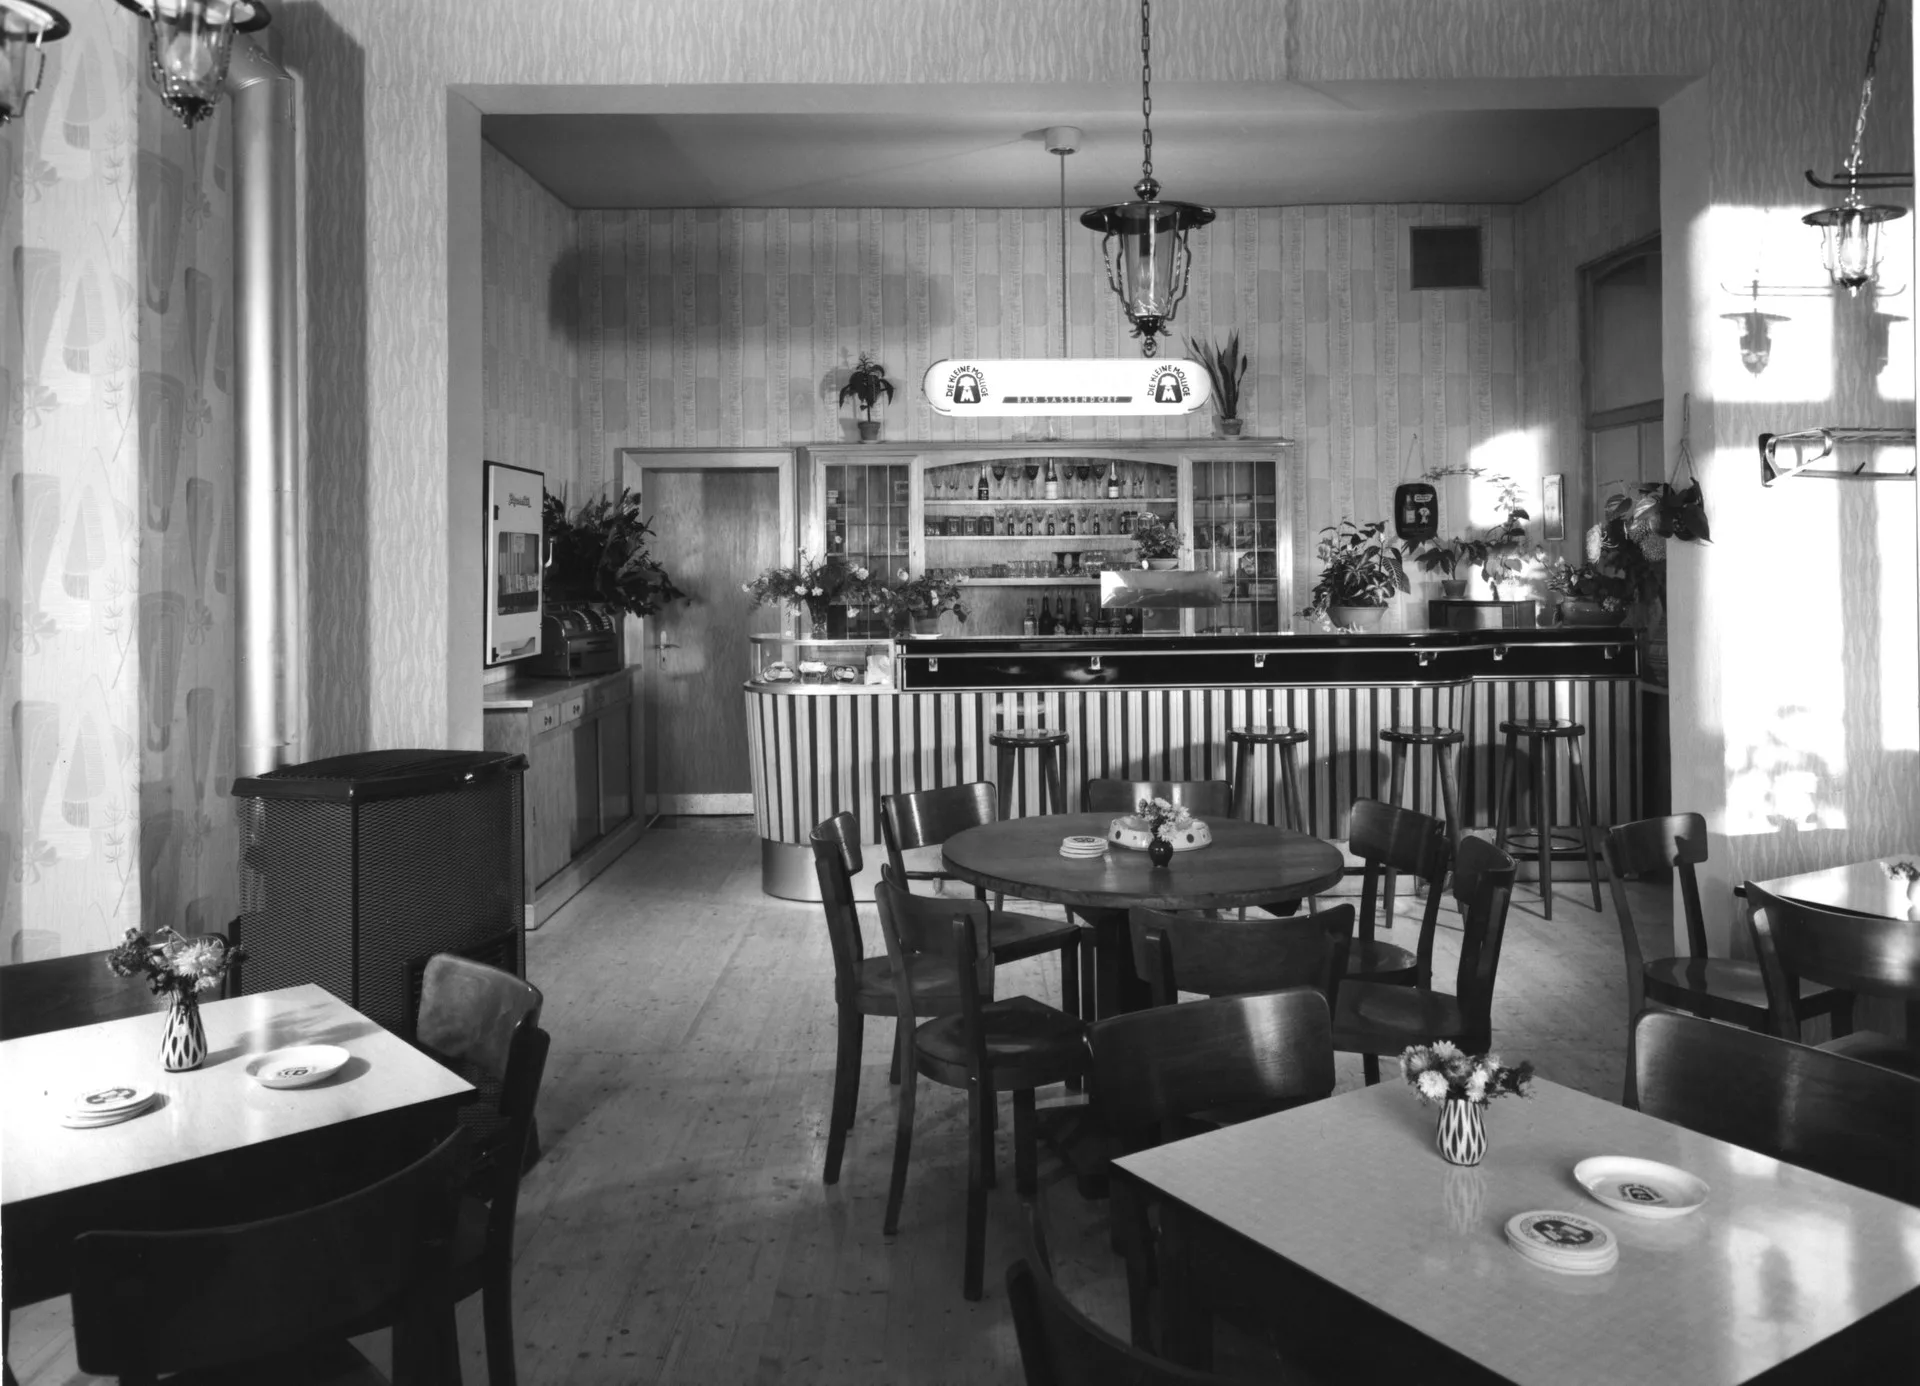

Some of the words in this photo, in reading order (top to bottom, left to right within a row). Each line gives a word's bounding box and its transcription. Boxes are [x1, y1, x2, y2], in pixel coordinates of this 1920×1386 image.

[948, 365, 971, 383] KLEINE
[971, 367, 989, 397] MOLLIGE
[1150, 364, 1173, 383] KLEINE
[1172, 366, 1191, 397] MOLLIGE
[945, 384, 955, 397] DIE
[1147, 383, 1156, 396] DIE
